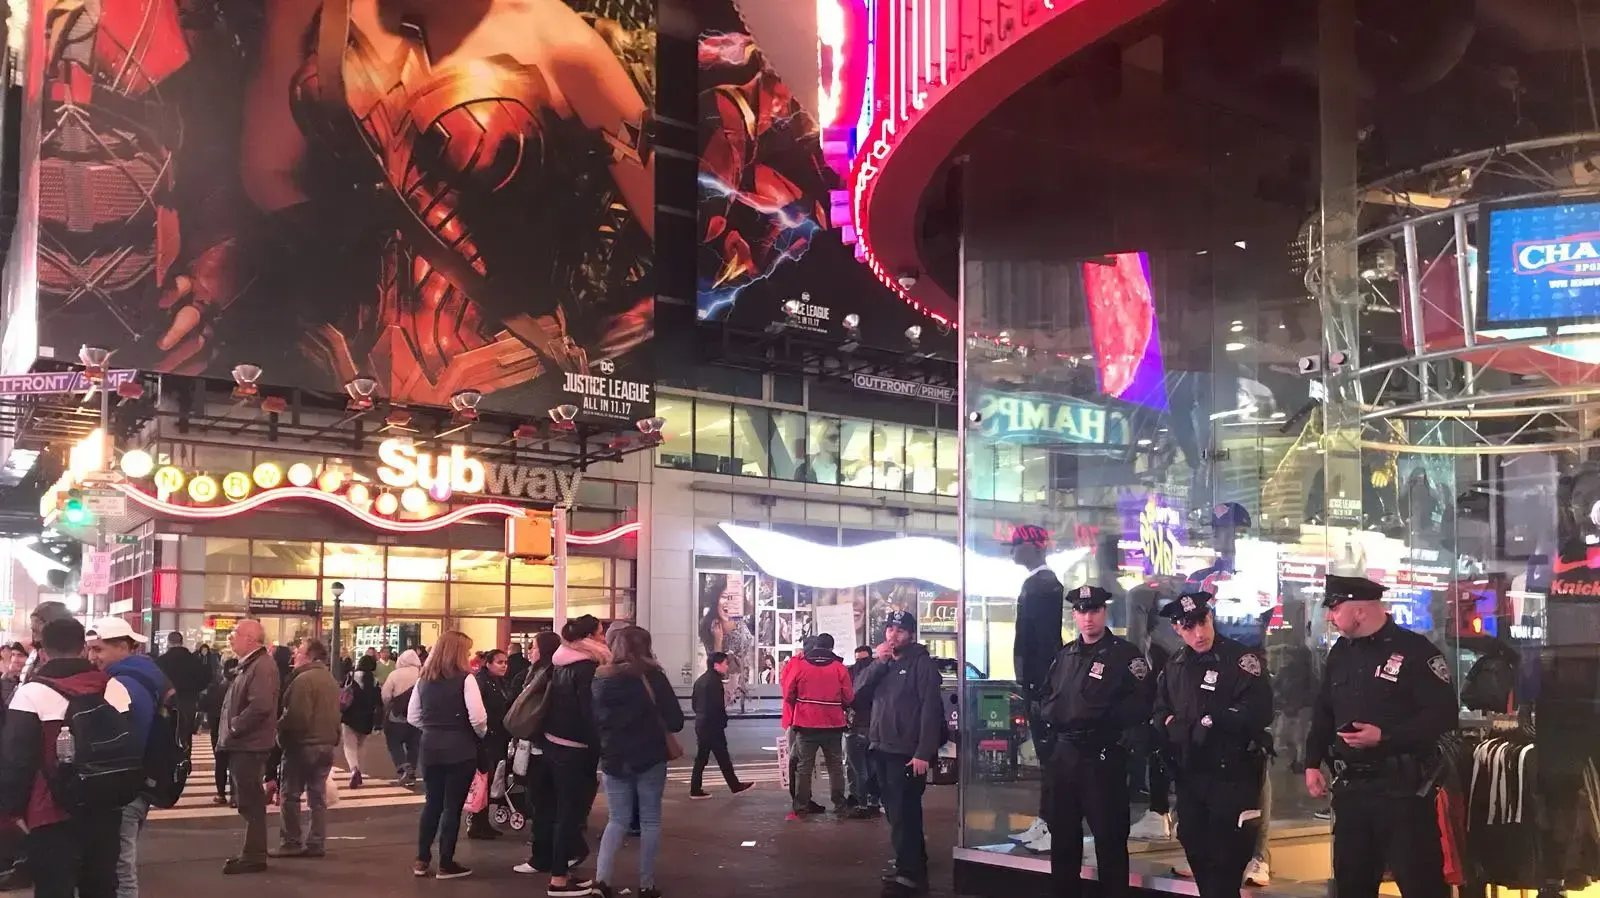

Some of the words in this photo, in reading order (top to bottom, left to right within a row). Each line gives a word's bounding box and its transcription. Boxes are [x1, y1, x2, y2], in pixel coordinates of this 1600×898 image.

[806, 304, 830, 320] LEAGUE
[600, 360, 615, 373] DC
[562, 371, 607, 397] JUSTICE
[609, 378, 650, 404] LEAGUE
[921, 386, 950, 399] PRIME
[583, 396, 598, 411] ALL
[600, 399, 609, 413] IN
[610, 400, 632, 415] 11.17
[376, 438, 582, 509] Subway
